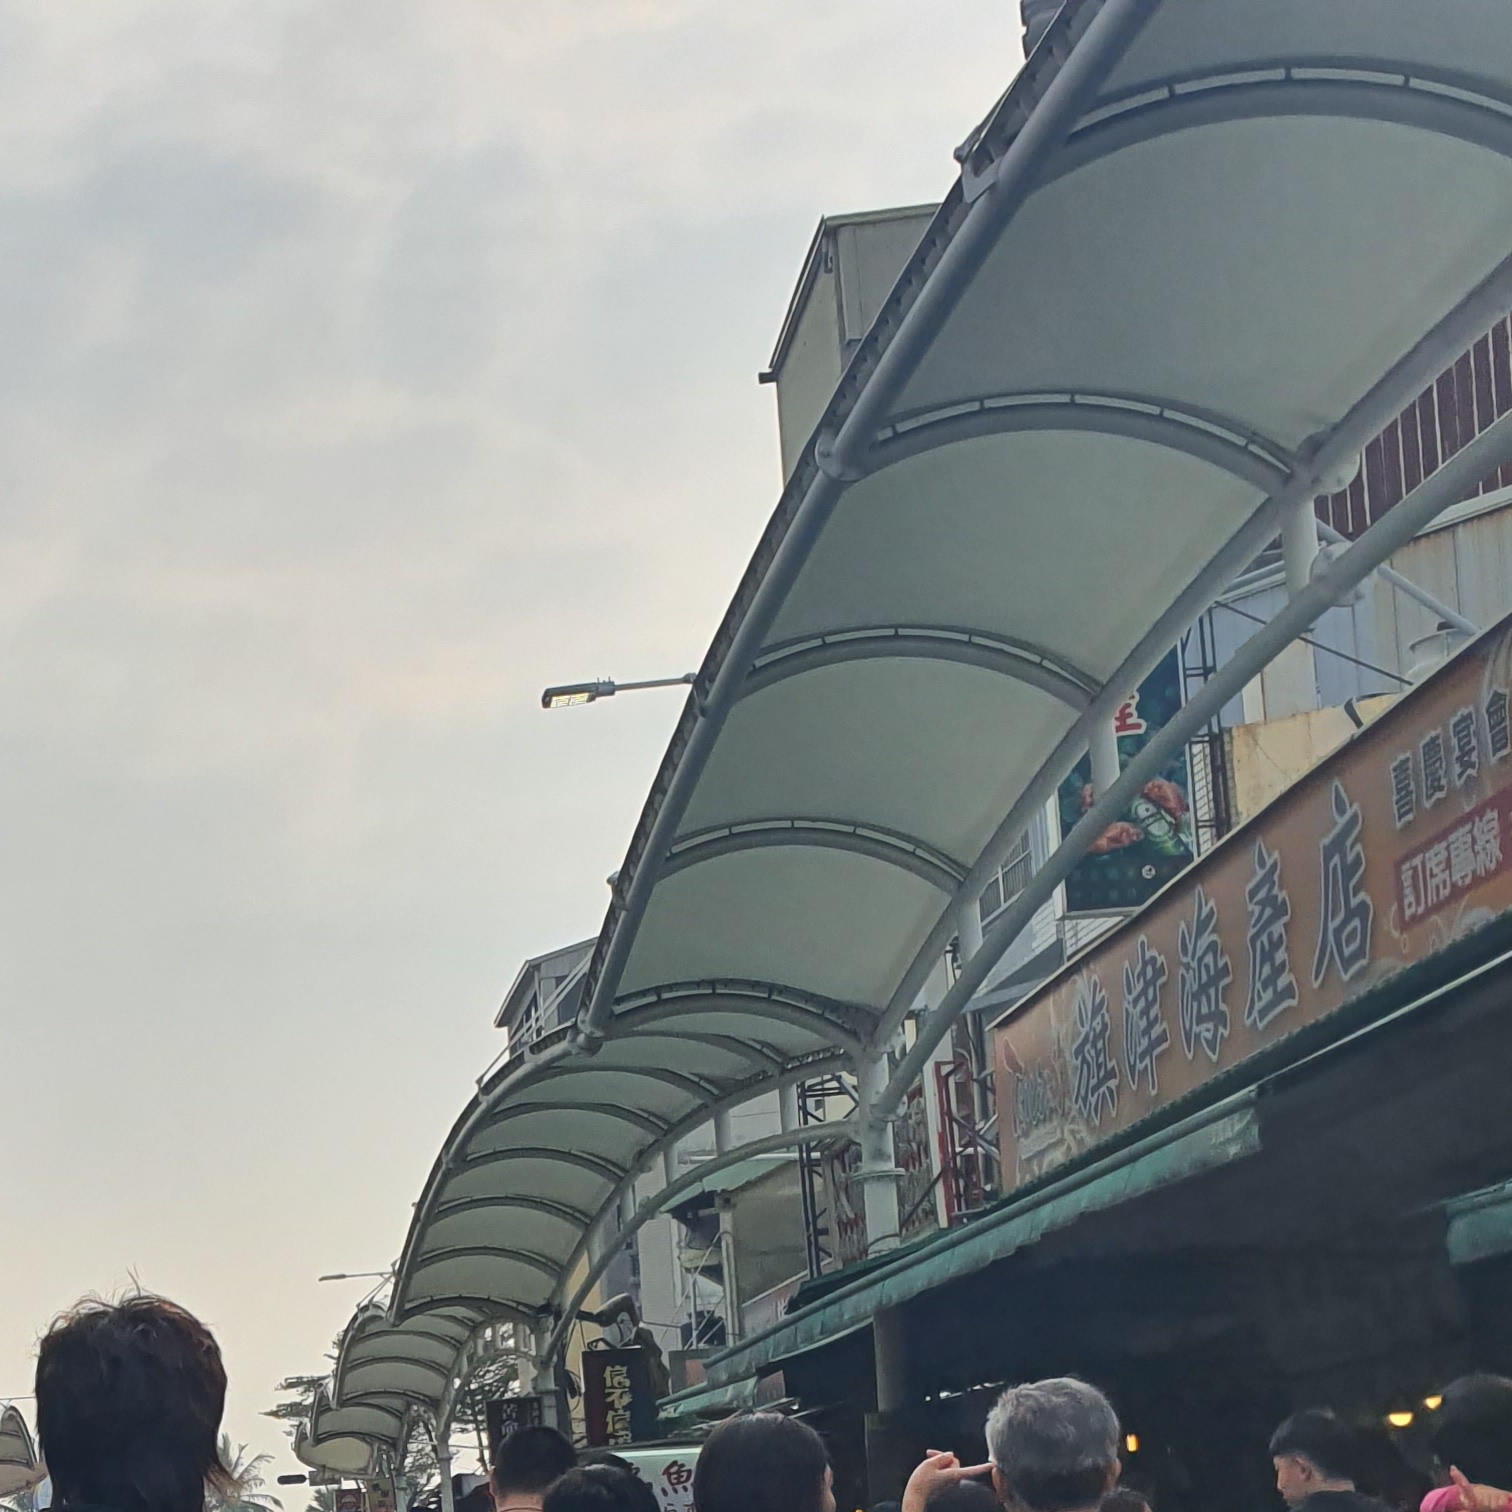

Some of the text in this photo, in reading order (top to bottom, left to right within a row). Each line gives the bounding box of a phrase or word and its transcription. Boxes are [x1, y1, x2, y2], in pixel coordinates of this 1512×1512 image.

[1072, 778, 1376, 1127] 旗津海產店
